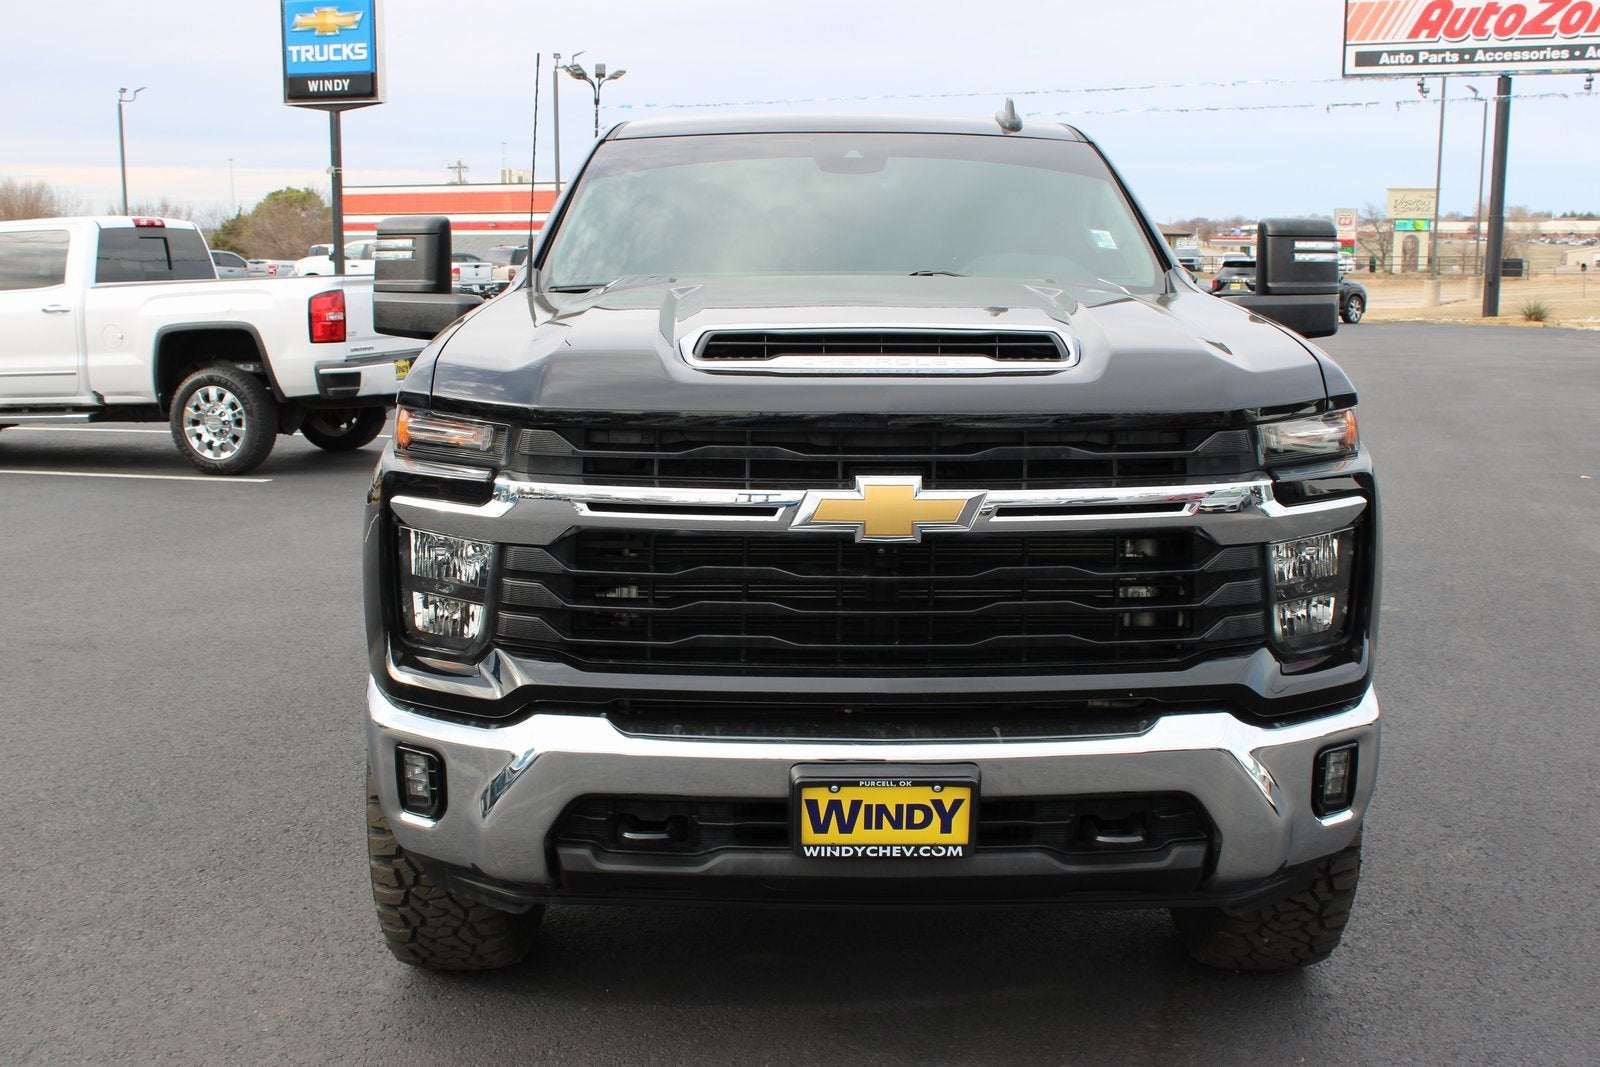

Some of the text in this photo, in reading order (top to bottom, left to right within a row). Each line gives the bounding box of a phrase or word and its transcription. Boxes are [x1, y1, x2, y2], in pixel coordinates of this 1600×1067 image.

[288, 42, 368, 63] TRUCKS
[1379, 45, 1600, 65] Auto Parts Accessories A
[307, 79, 350, 92] WINDY
[804, 798, 966, 835] WINDY
[803, 846, 963, 857] WINDYCHEV.COM
